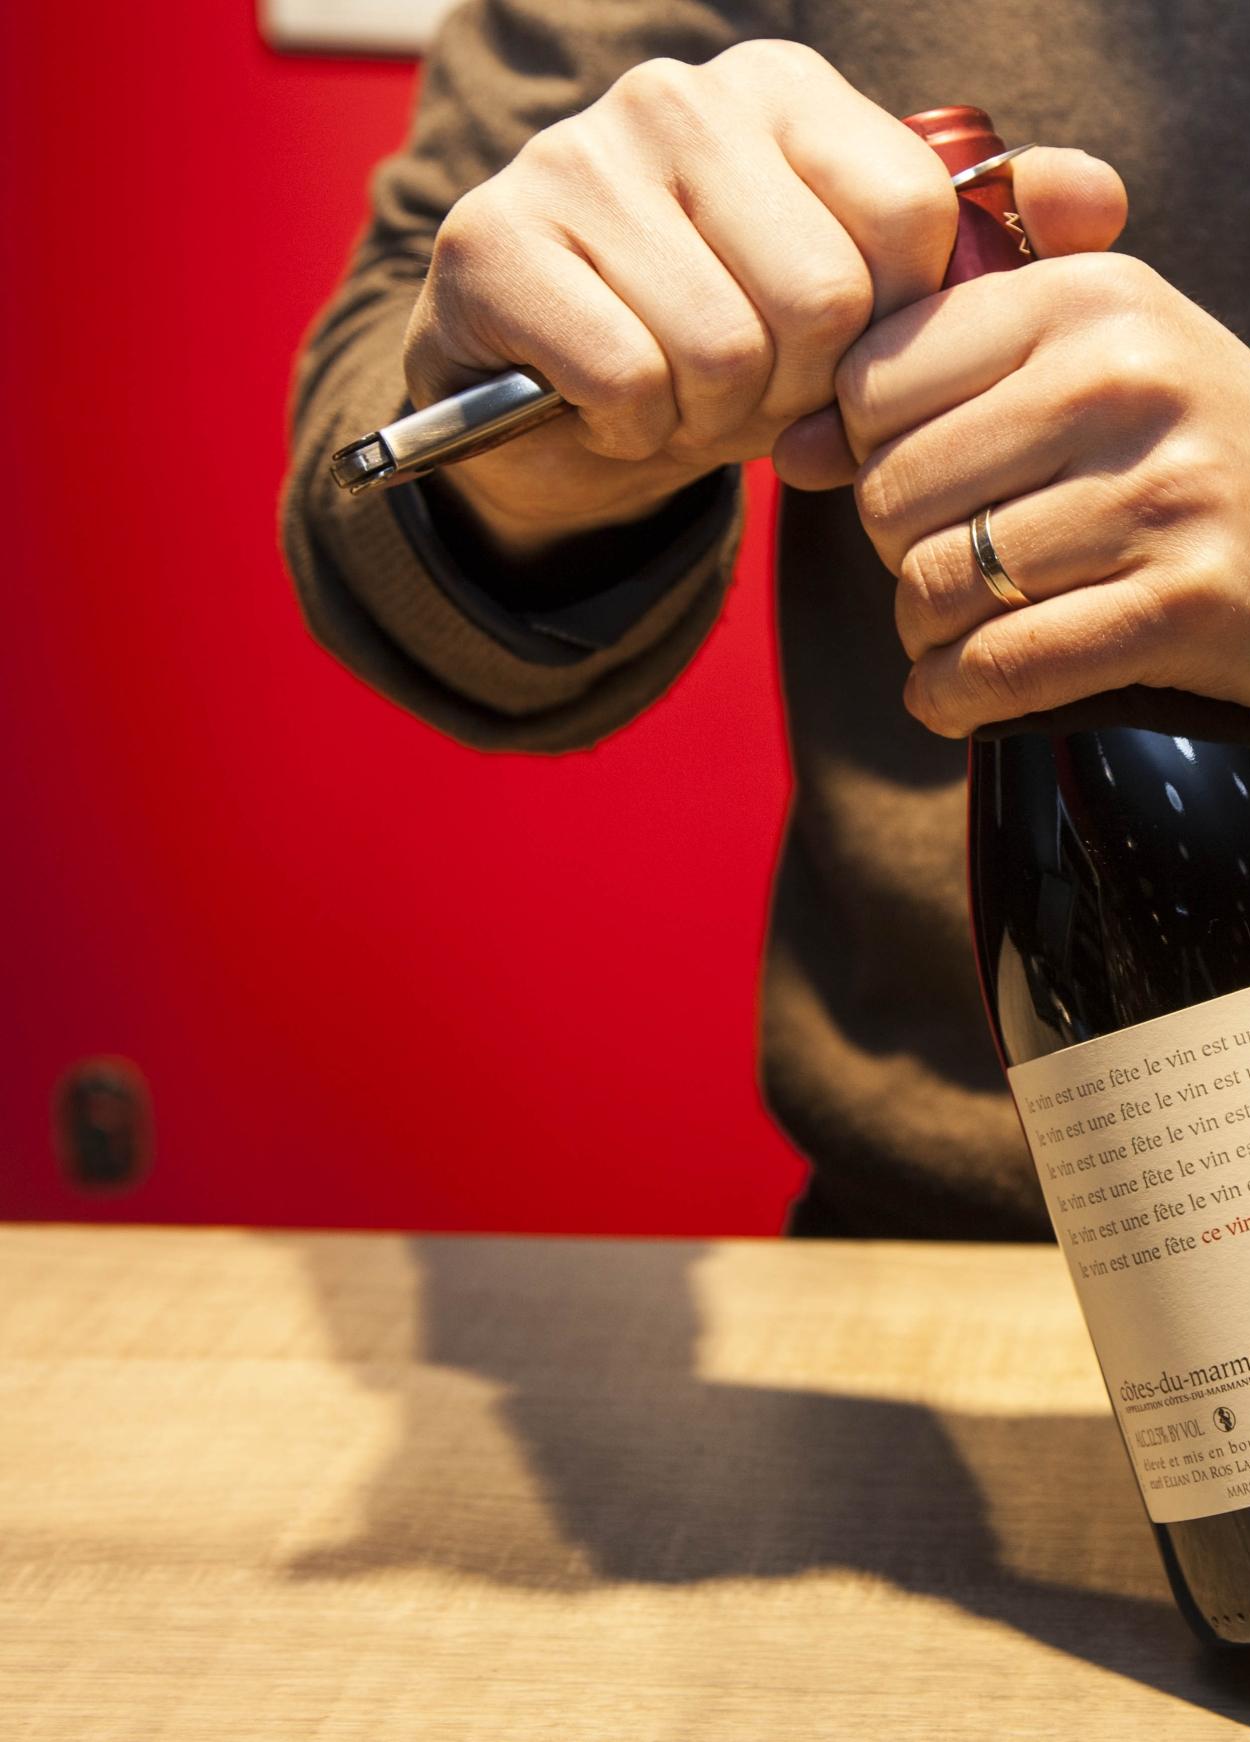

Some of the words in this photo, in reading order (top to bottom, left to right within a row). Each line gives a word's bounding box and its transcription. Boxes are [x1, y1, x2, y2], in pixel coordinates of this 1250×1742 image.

[1035, 1095, 1054, 1110] vin
[1056, 1088, 1074, 1104] est
[1076, 1079, 1105, 1097] une
[1110, 1068, 1140, 1087] fête
[1144, 1059, 1161, 1075] le
[1165, 1050, 1197, 1067] vin
[1202, 1037, 1229, 1056] est
[1046, 1128, 1064, 1143] vin
[1066, 1121, 1085, 1138] est
[1087, 1113, 1117, 1131] une
[1121, 1101, 1152, 1121] fête
[1155, 1093, 1173, 1109] le
[1177, 1084, 1208, 1101] vin
[1214, 1071, 1241, 1090] est
[1057, 1160, 1075, 1176] vin
[1077, 1154, 1096, 1171] est
[1098, 1146, 1127, 1164] une
[1132, 1136, 1162, 1155] fête
[1166, 1126, 1184, 1143] le
[1188, 1117, 1219, 1135] vin
[1067, 1194, 1086, 1209] vin
[1088, 1187, 1107, 1204] est
[1109, 1180, 1138, 1198] une
[1143, 1169, 1174, 1188] fête
[1177, 1160, 1195, 1177] le
[1199, 1152, 1230, 1169] vin
[1078, 1227, 1097, 1242] vin
[1099, 1221, 1118, 1238] est
[1120, 1214, 1150, 1231] une
[1154, 1203, 1185, 1222] fête
[1188, 1194, 1206, 1211] le
[1210, 1185, 1242, 1203] vin
[1089, 1260, 1108, 1276] vin
[1110, 1254, 1130, 1271] est
[1132, 1247, 1161, 1265] une
[1165, 1237, 1196, 1255] fête
[1202, 1228, 1221, 1243] ce
[1167, 1424, 1180, 1442] BY
[1169, 1457, 1179, 1467] et
[1183, 1451, 1204, 1464] mis
[1209, 1448, 1224, 1459] en
